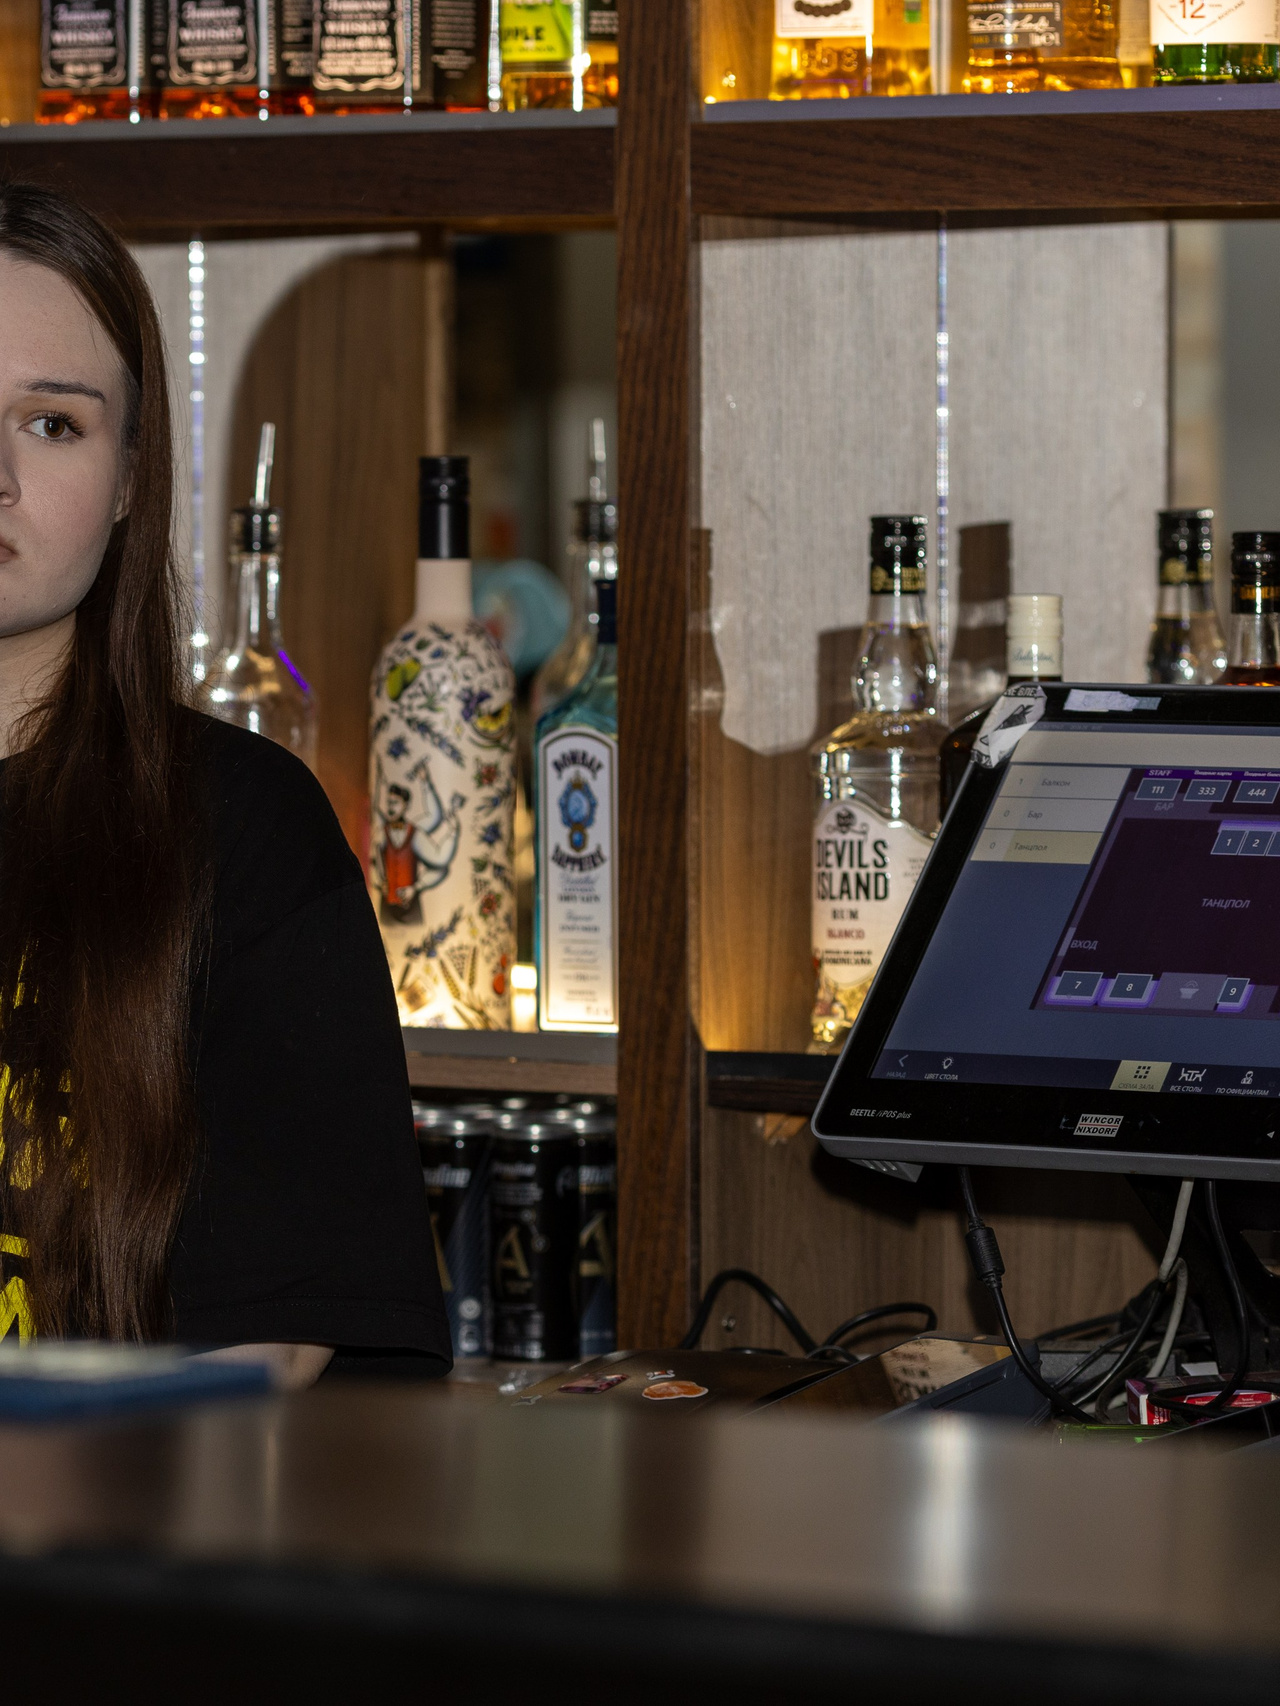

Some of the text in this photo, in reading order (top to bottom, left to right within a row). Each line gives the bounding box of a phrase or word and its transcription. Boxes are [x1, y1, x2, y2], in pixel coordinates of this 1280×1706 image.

[1151, 786, 1165, 794] 111
[1198, 787, 1216, 795] 333
[1247, 788, 1267, 797] 444
[1154, 803, 1174, 812] БАР
[1028, 811, 1043, 820] Бар
[1014, 843, 1048, 852] Танцпол
[1252, 839, 1260, 848] 2
[816, 839, 888, 868] DEVILS
[817, 871, 889, 901] ISLAND
[1201, 898, 1250, 909] ТАНЦПОЛ
[1070, 940, 1098, 951] ВХОД
[1075, 981, 1081, 990] 7
[1126, 983, 1133, 992] 8
[1229, 987, 1237, 996] 9
[850, 1108, 876, 1117] BEETLE
[896, 1111, 912, 1119] plus
[1081, 1116, 1122, 1125] WINCOR
[1076, 1126, 1117, 1135] NIXDORF
